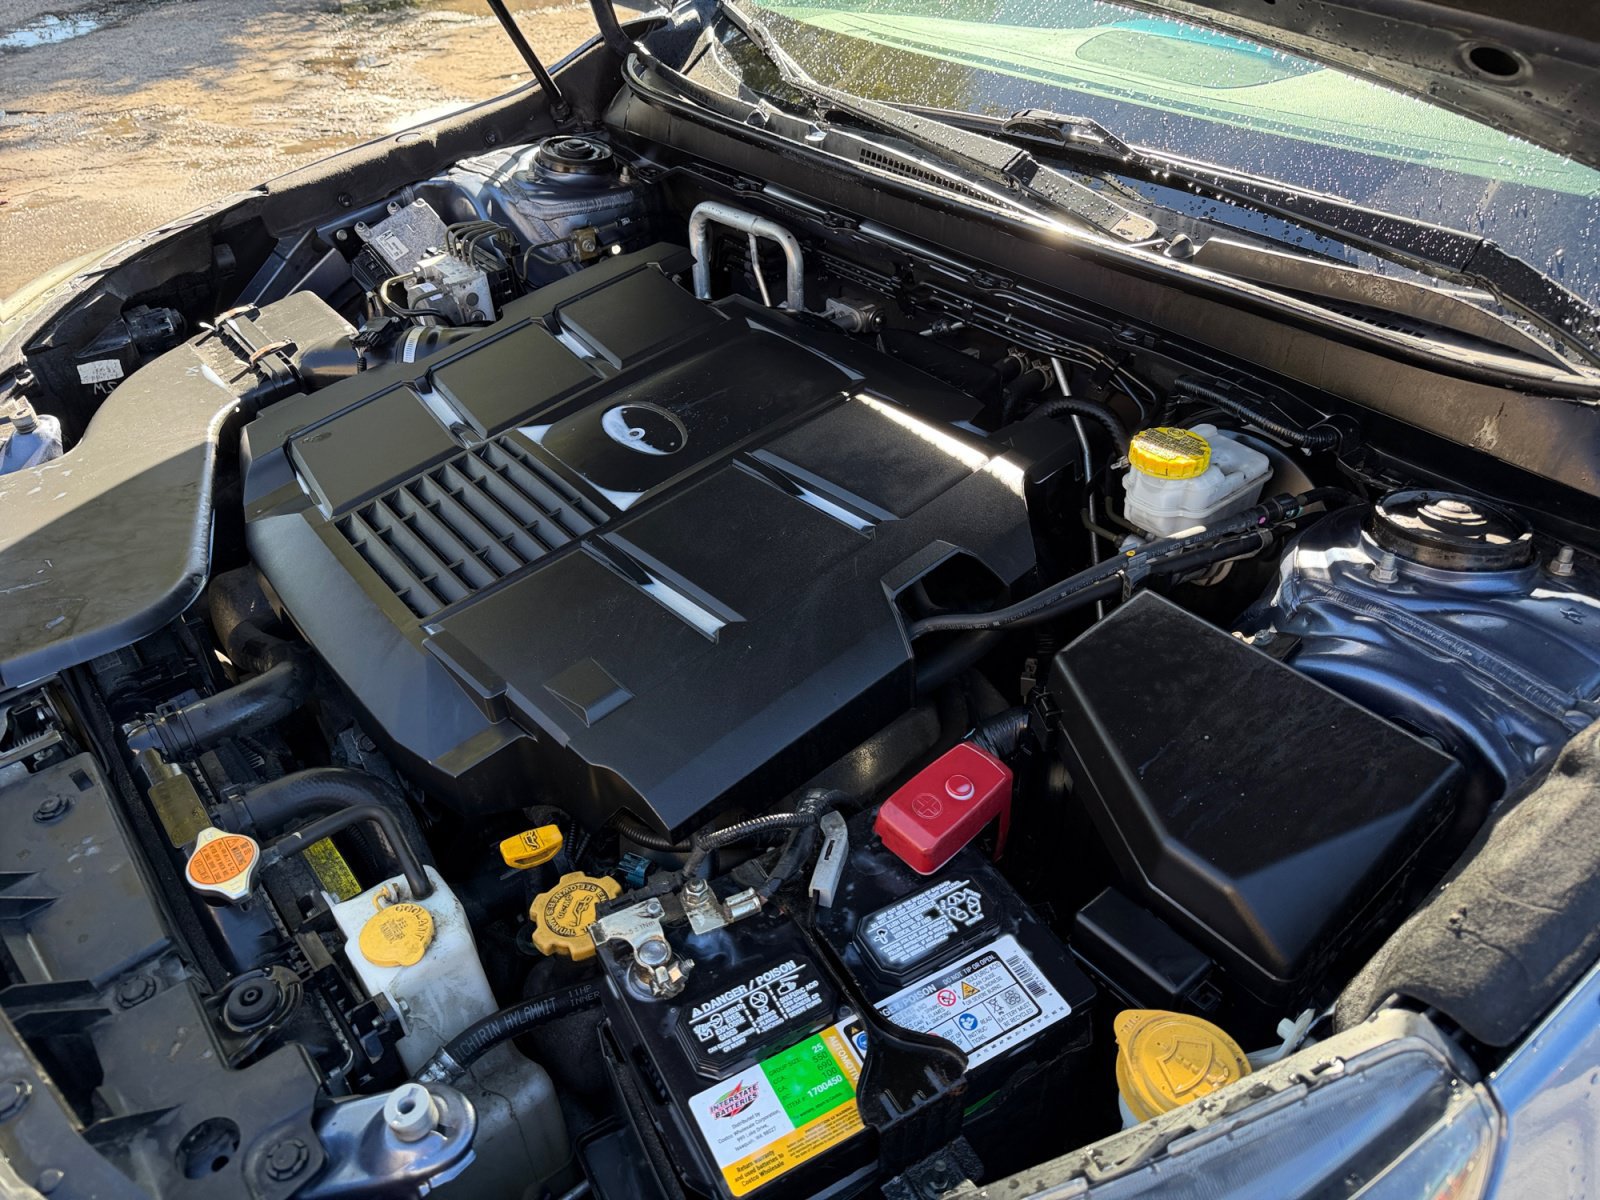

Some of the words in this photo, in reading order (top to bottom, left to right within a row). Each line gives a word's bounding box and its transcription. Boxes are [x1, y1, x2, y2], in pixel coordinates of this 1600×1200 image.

[395, 904, 428, 941] COOLANT
[546, 918, 576, 936] MANUAL
[942, 976, 952, 985] DO
[950, 971, 963, 980] NOT
[962, 966, 972, 974] TIP
[971, 961, 981, 970] OR
[988, 961, 1001, 971] ACID
[700, 983, 747, 1013] DANGER
[755, 959, 796, 985] POISON
[972, 979, 982, 987] CAN
[981, 972, 995, 982] CAUSE
[569, 990, 601, 1006] INNER
[971, 990, 988, 1002] SEVERE
[503, 996, 558, 1029] HYLAMMIT
[757, 1004, 769, 1015] NO
[997, 1008, 1018, 1022] BATTERY
[1017, 1001, 1031, 1011] MUST
[1009, 1007, 1034, 1023] RECYCLED
[979, 1015, 992, 1025] READ
[810, 1041, 824, 1054] 25
[811, 1050, 828, 1063] 550
[815, 1058, 833, 1071] 690
[821, 1065, 838, 1079] 100
[806, 1073, 844, 1098] 1700450
[709, 1083, 758, 1113] INTERSTATE
[713, 1092, 759, 1119] BATTERIES
[731, 1116, 750, 1129] Distributed
[750, 1111, 761, 1120] by
[717, 1133, 733, 1144] Costco
[733, 1121, 755, 1136] Wholesale
[736, 1134, 746, 1142] 999
[745, 1128, 756, 1137] Lake
[762, 1126, 776, 1136] 98027
[733, 1173, 744, 1182] and
[742, 1166, 757, 1177] used
[755, 1154, 779, 1170] batteries
[736, 1159, 754, 1173] Return
[753, 1149, 775, 1164] warranty
[740, 1173, 759, 1187] Costco
[758, 1159, 785, 1177] Wholesale
